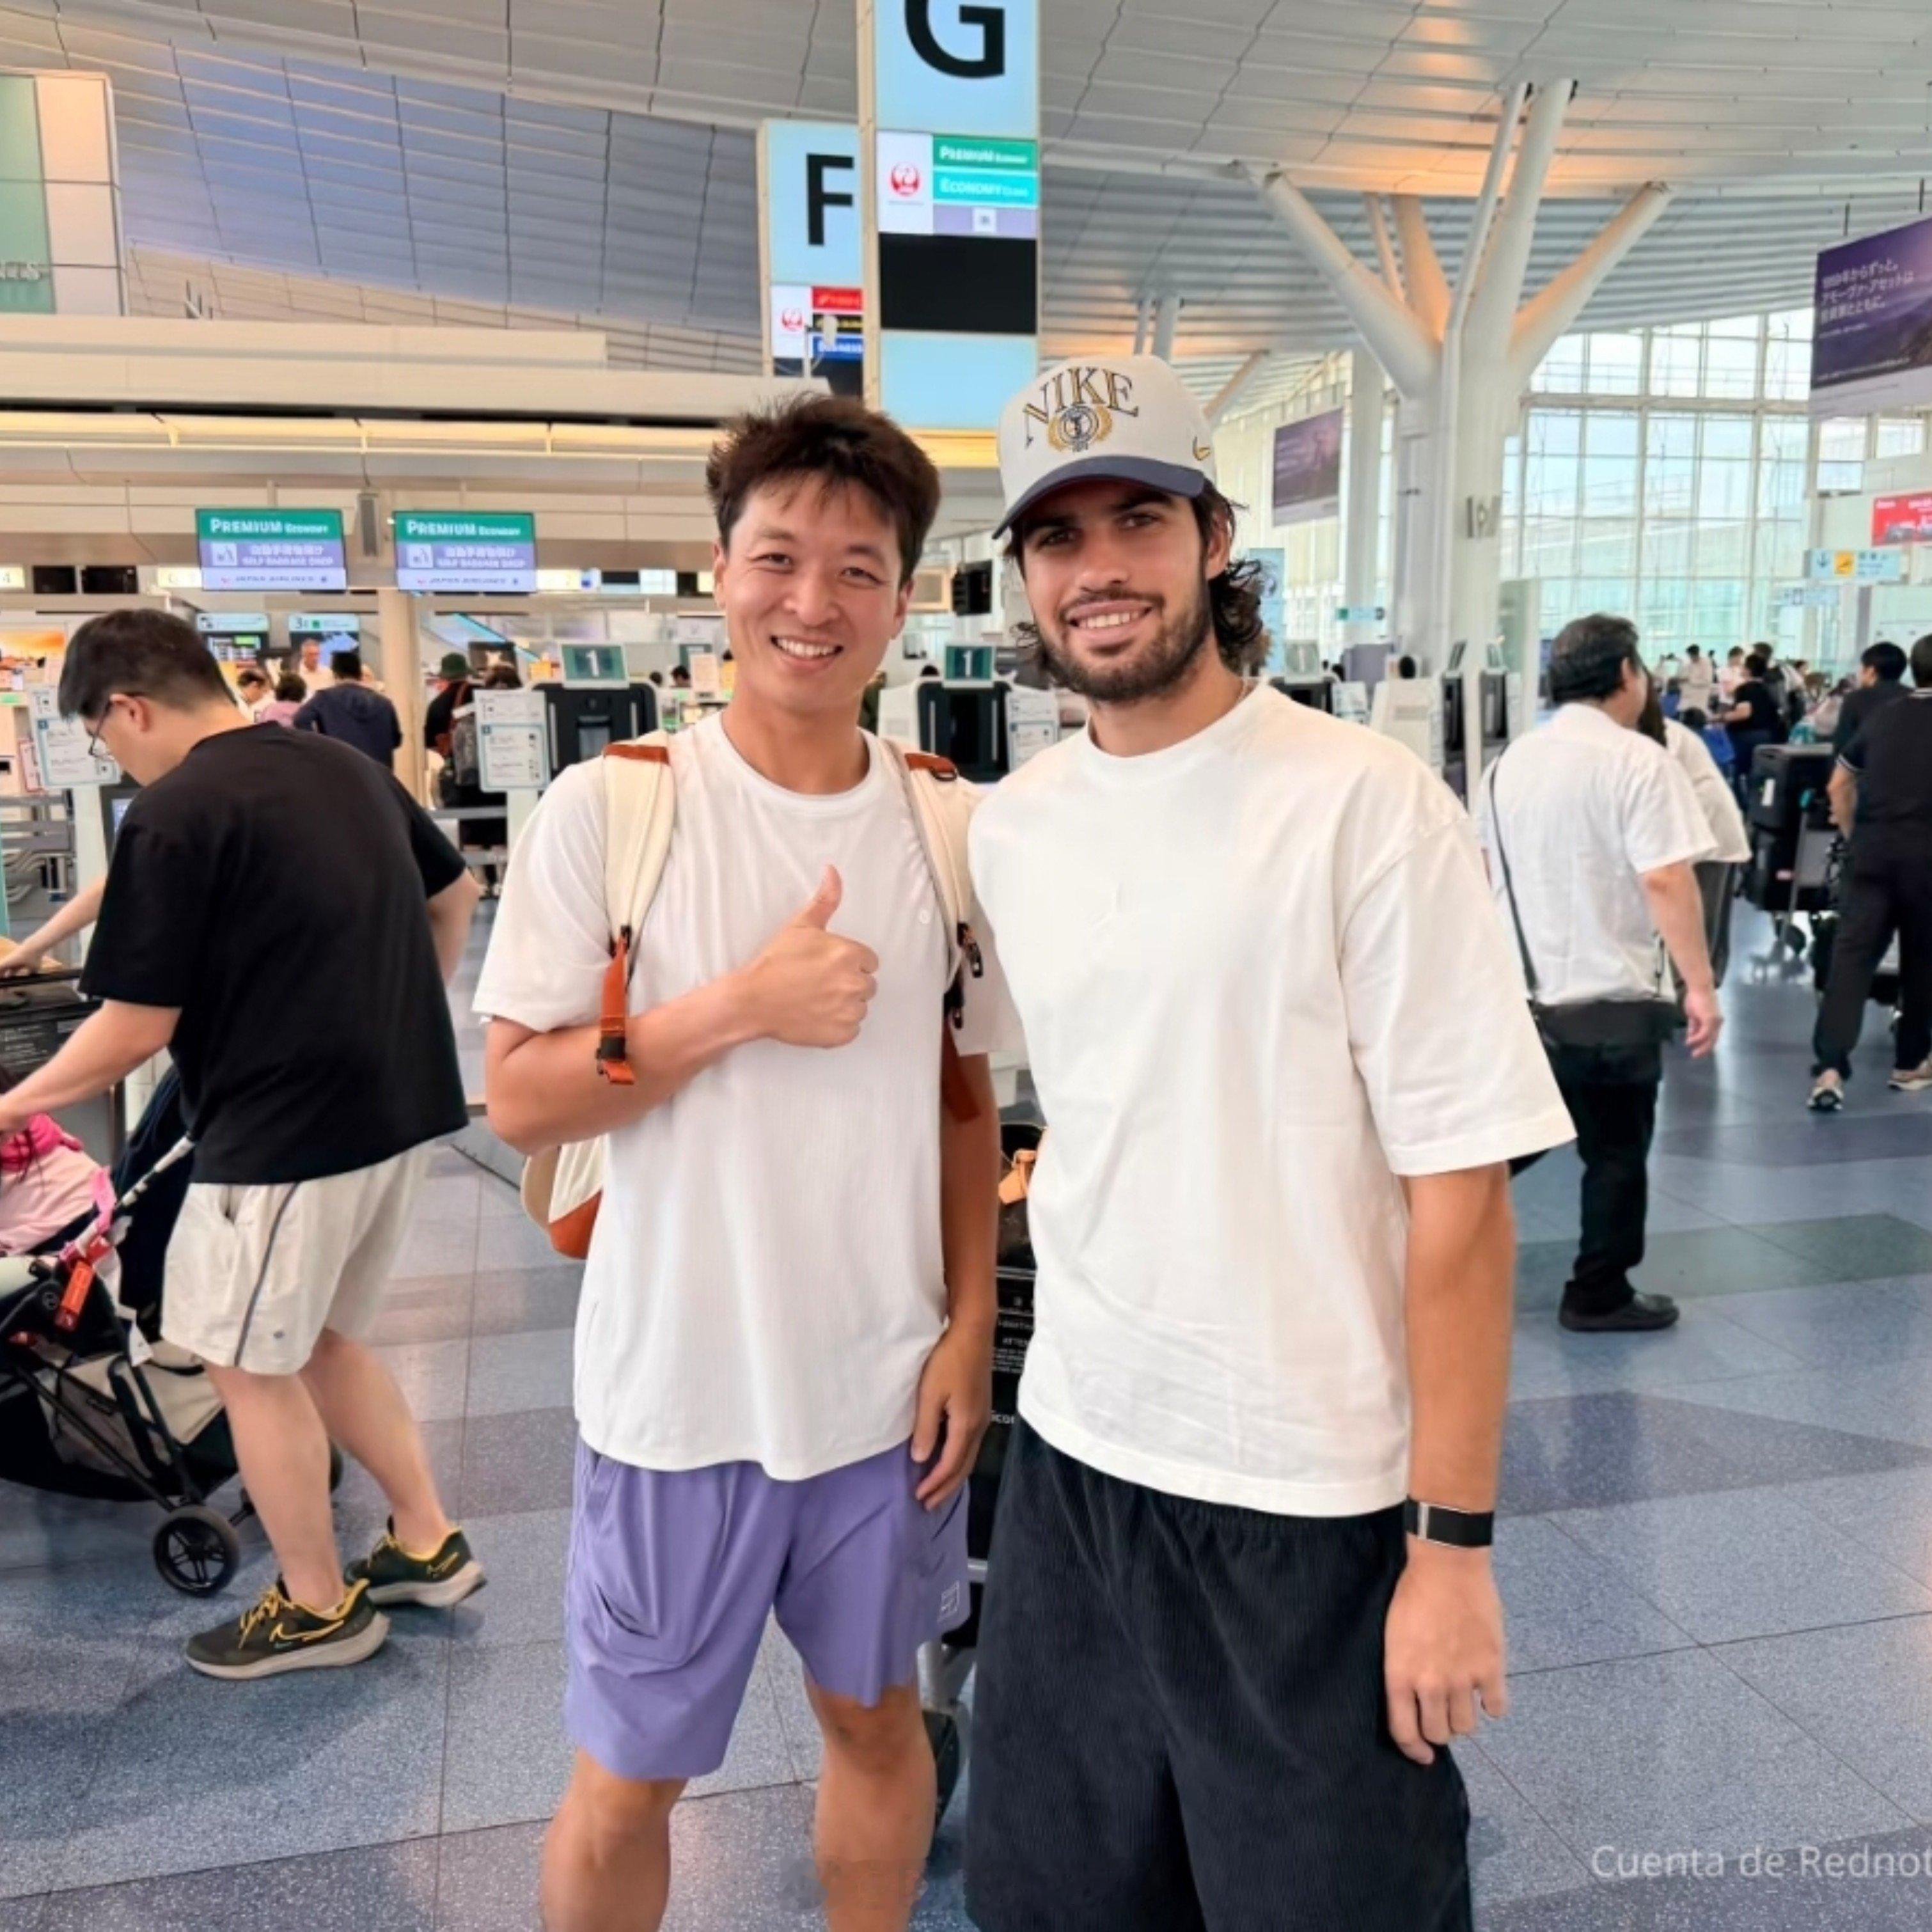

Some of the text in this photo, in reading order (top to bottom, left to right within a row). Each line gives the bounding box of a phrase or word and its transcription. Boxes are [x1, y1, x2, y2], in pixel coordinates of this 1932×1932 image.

[904, 0, 1005, 79] G
[806, 152, 854, 247] F
[1023, 366, 1139, 449] NIKE
[210, 517, 283, 533] PREMIUM
[406, 520, 477, 535] PREMIUM
[585, 650, 599, 677] 1
[963, 650, 974, 676] 1
